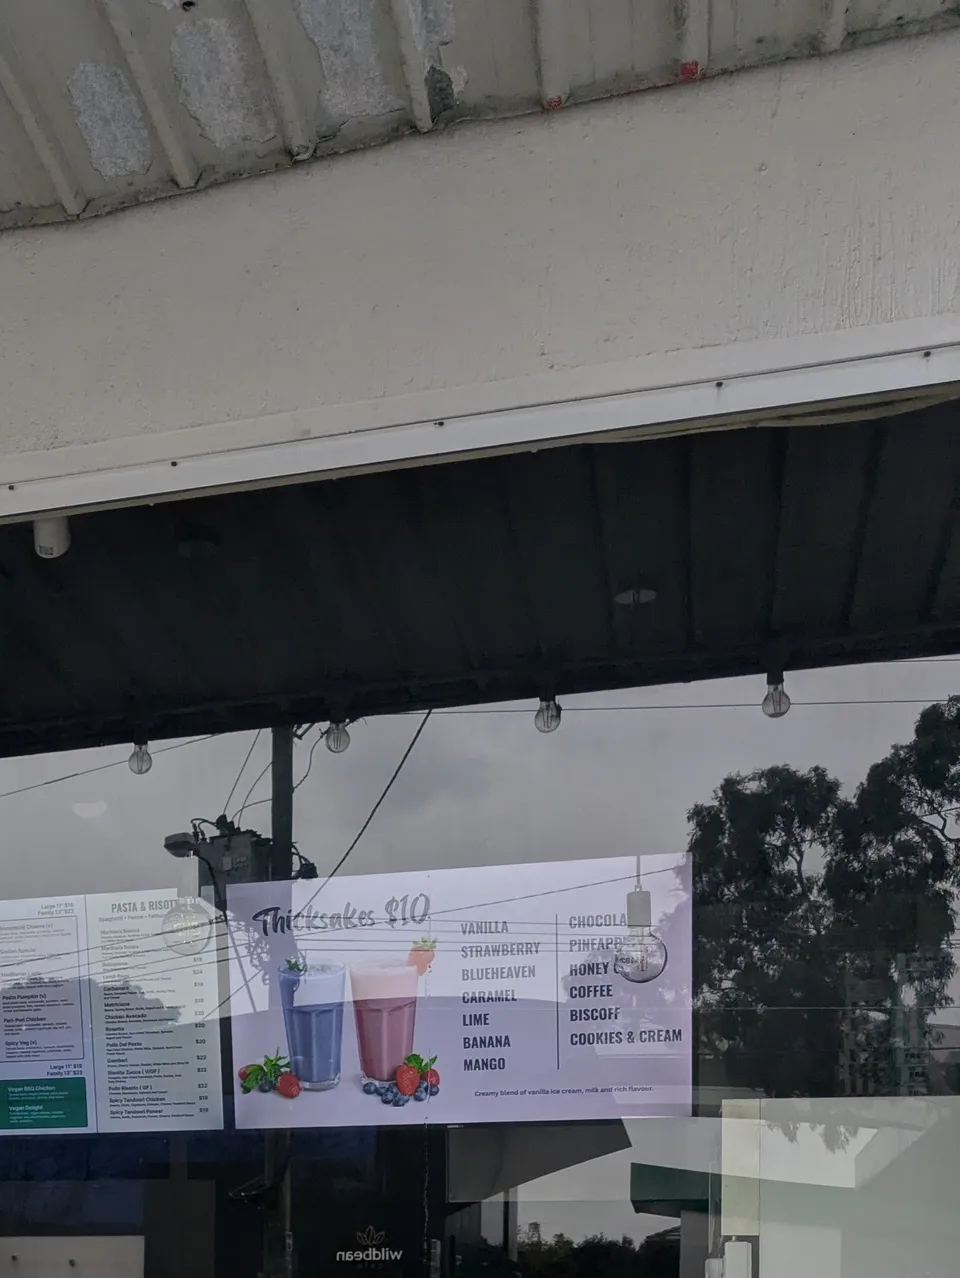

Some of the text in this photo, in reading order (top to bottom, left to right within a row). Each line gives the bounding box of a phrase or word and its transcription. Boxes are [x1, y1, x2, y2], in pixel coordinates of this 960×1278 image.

[111, 899, 177, 913] PASTA & RISOT
[385, 892, 430, 928] $10
[569, 913, 627, 928] CHOCOLA
[461, 921, 508, 935] VANILLA
[461, 942, 540, 958] STRAWBERRY
[569, 937, 622, 952] PINEAPP
[462, 965, 535, 981] BLUEHEAVEN
[570, 962, 609, 976] HONEY
[462, 989, 517, 1004] CARAMEL
[570, 985, 613, 999] COFFEE
[463, 1013, 489, 1027] LIME
[570, 1007, 620, 1022] BISCOFF
[463, 1035, 510, 1049] BANANA
[570, 1029, 682, 1045] COOKIES & CREAM
[464, 1058, 505, 1071] MANGO
[474, 1090, 499, 1098] Creamy
[561, 1088, 584, 1096] cream,
[25, 1104, 43, 1112] Delight
